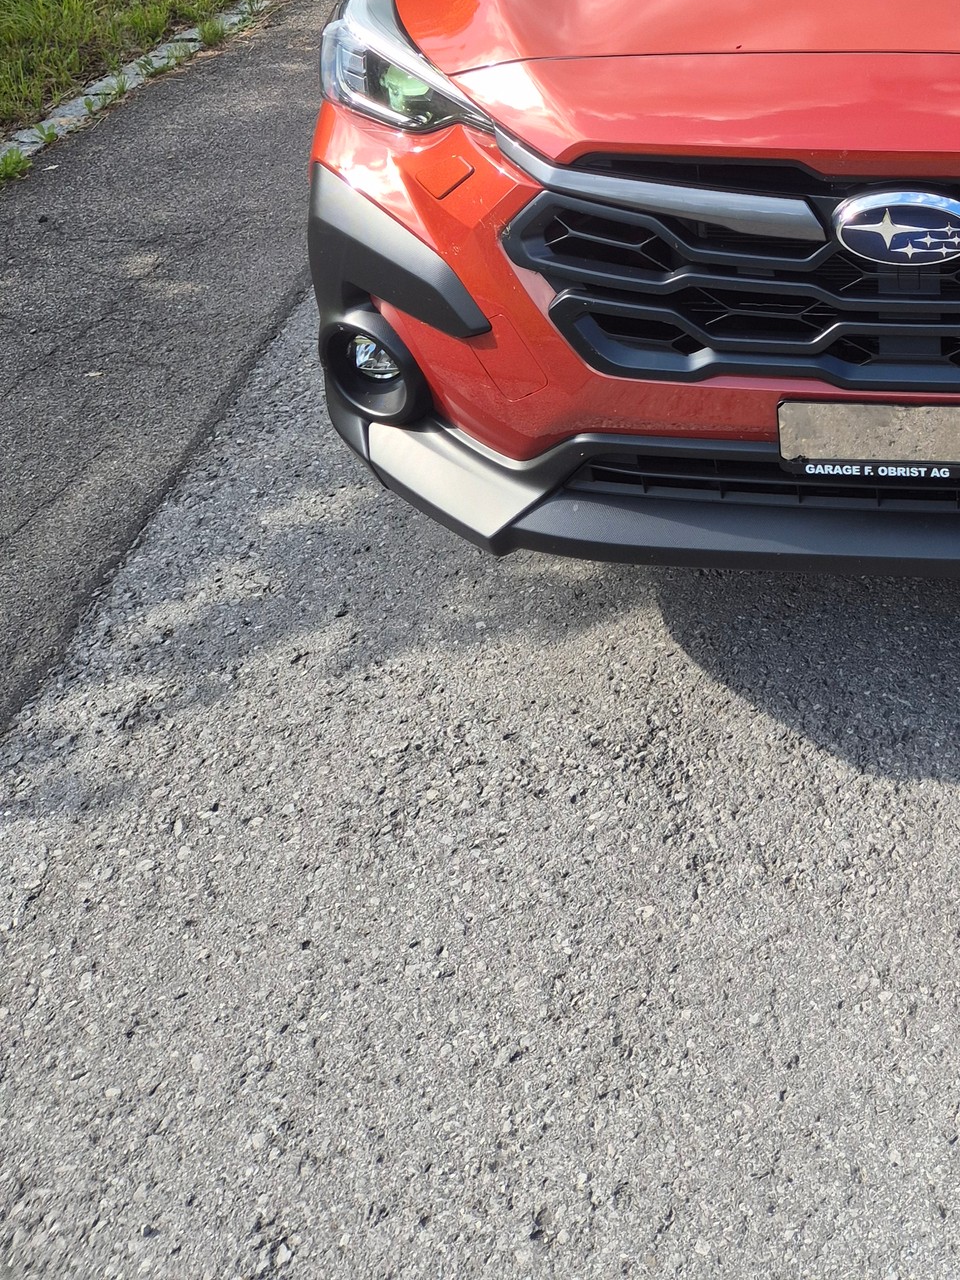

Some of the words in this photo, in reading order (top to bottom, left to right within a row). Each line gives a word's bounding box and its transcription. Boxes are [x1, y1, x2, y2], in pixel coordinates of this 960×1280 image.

[805, 464, 860, 476] GARAGE
[864, 466, 874, 476] F.
[877, 466, 928, 477] OBRIST
[930, 468, 950, 478] AG
